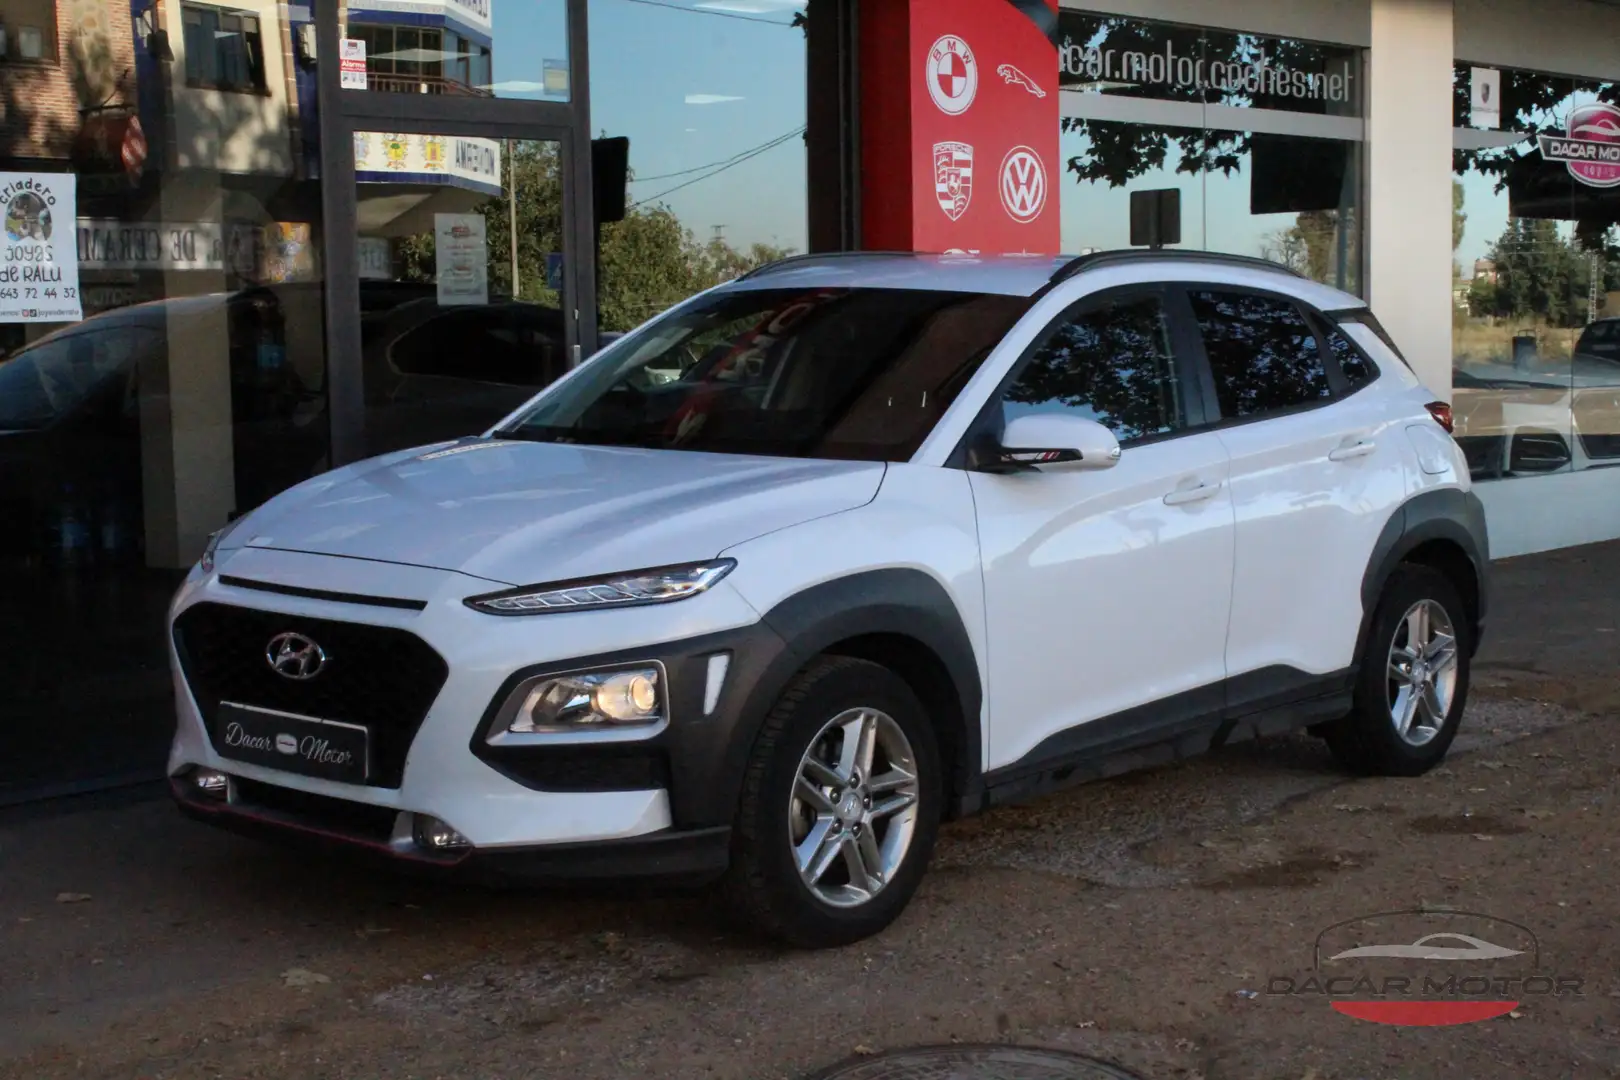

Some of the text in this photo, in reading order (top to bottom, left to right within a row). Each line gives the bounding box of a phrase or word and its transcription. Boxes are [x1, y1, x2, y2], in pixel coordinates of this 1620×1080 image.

[1551, 142, 1596, 159] DACAR
[0, 287, 76, 299] 643 72 44 32
[224, 722, 353, 765] Dacar Motor
